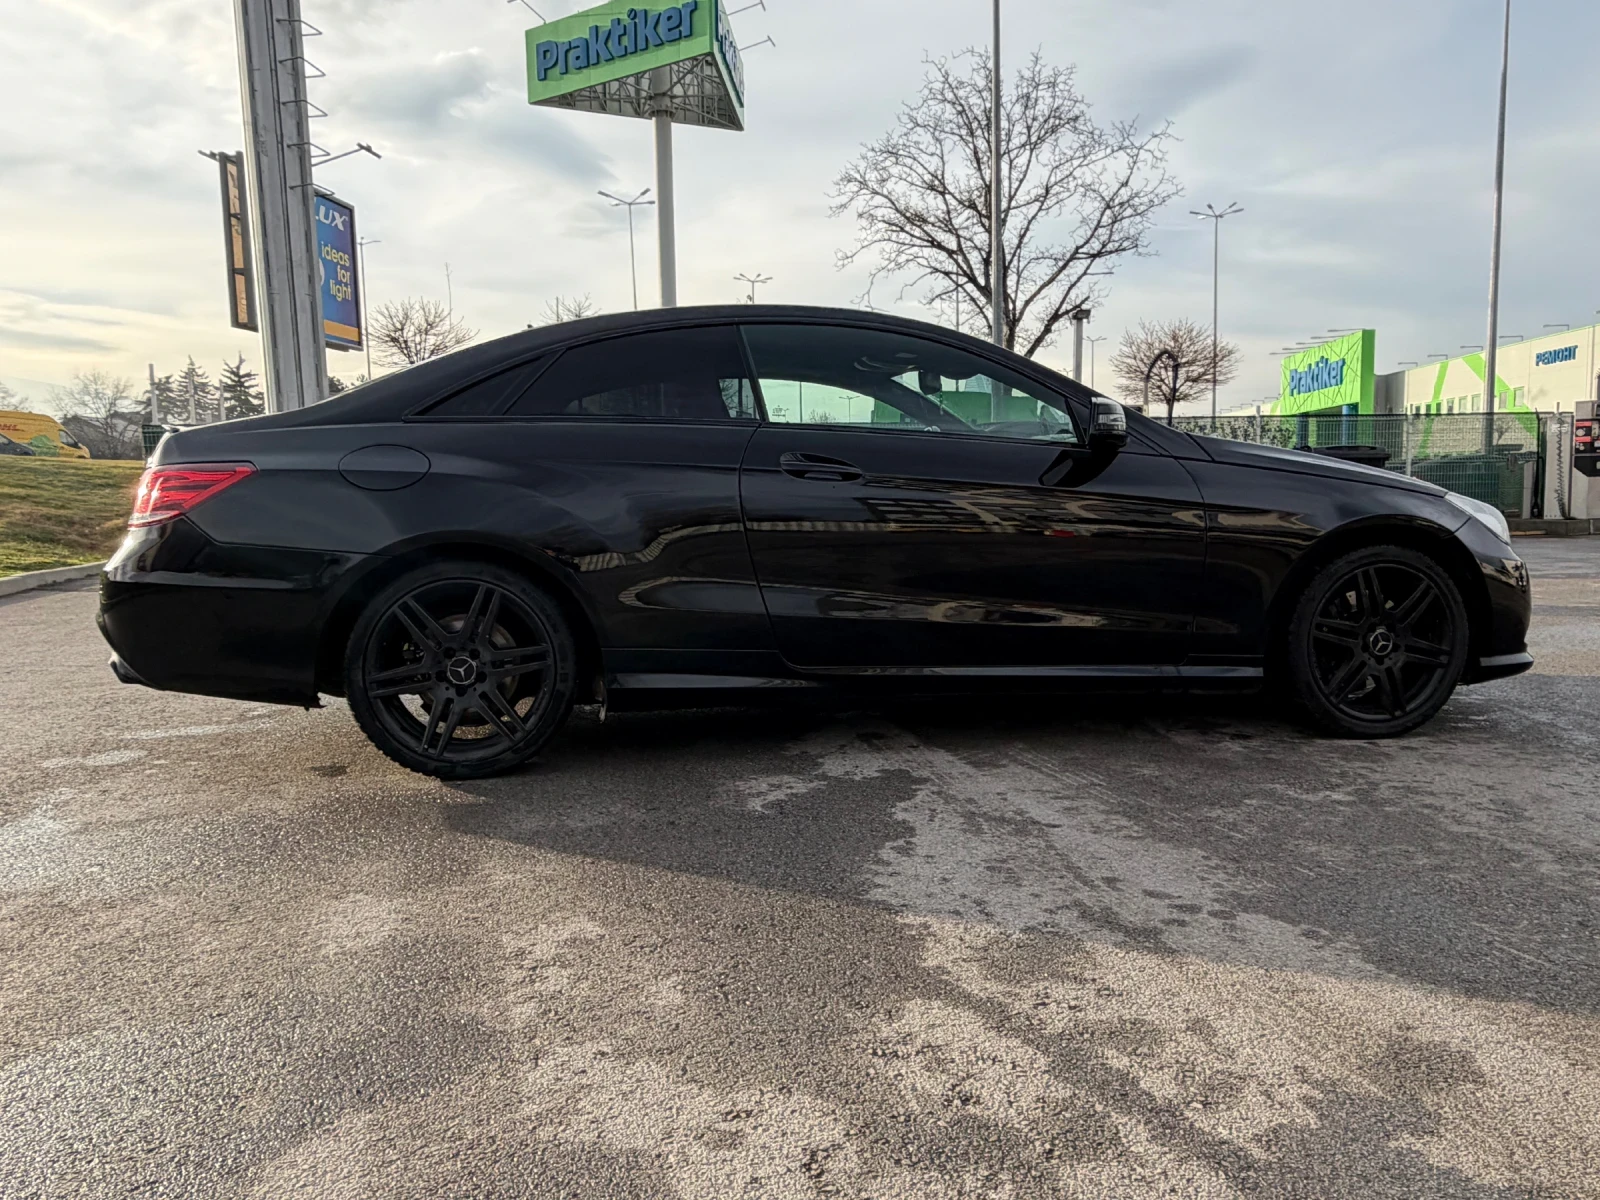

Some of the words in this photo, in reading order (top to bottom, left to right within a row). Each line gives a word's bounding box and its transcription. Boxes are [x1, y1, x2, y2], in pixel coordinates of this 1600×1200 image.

[535, 0, 697, 81] Praktiker
[321, 241, 350, 266] ideas
[337, 265, 351, 284] for
[330, 279, 352, 301] light
[1535, 344, 1578, 366] РЕМОНТ
[1289, 355, 1346, 397] Praktiker
